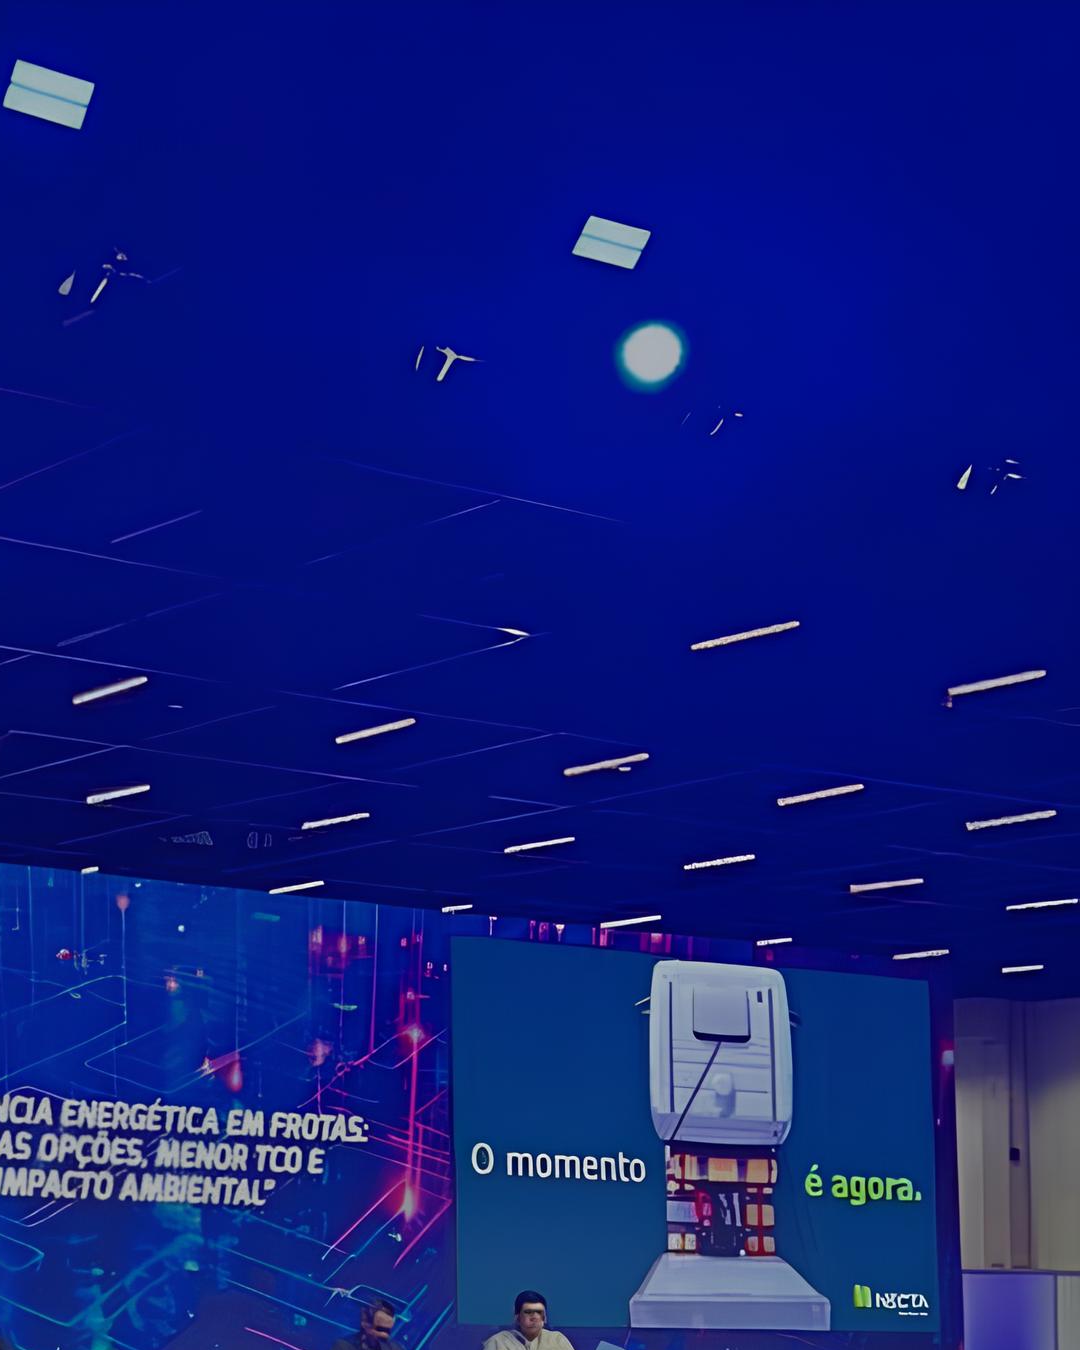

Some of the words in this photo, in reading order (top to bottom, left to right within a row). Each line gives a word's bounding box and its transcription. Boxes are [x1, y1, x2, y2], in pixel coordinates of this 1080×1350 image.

[60, 1097, 220, 1136] ENERGÉTICA
[226, 1109, 265, 1138] EM
[36, 1131, 149, 1169] OPÇÕES,
[154, 1138, 250, 1172] MENOR
[255, 1143, 303, 1173] TCO
[307, 1147, 326, 1174] E
[471, 1142, 495, 1175] O
[506, 1151, 647, 1183] momento
[804, 1164, 823, 1197] é
[831, 1174, 922, 1206] agora.
